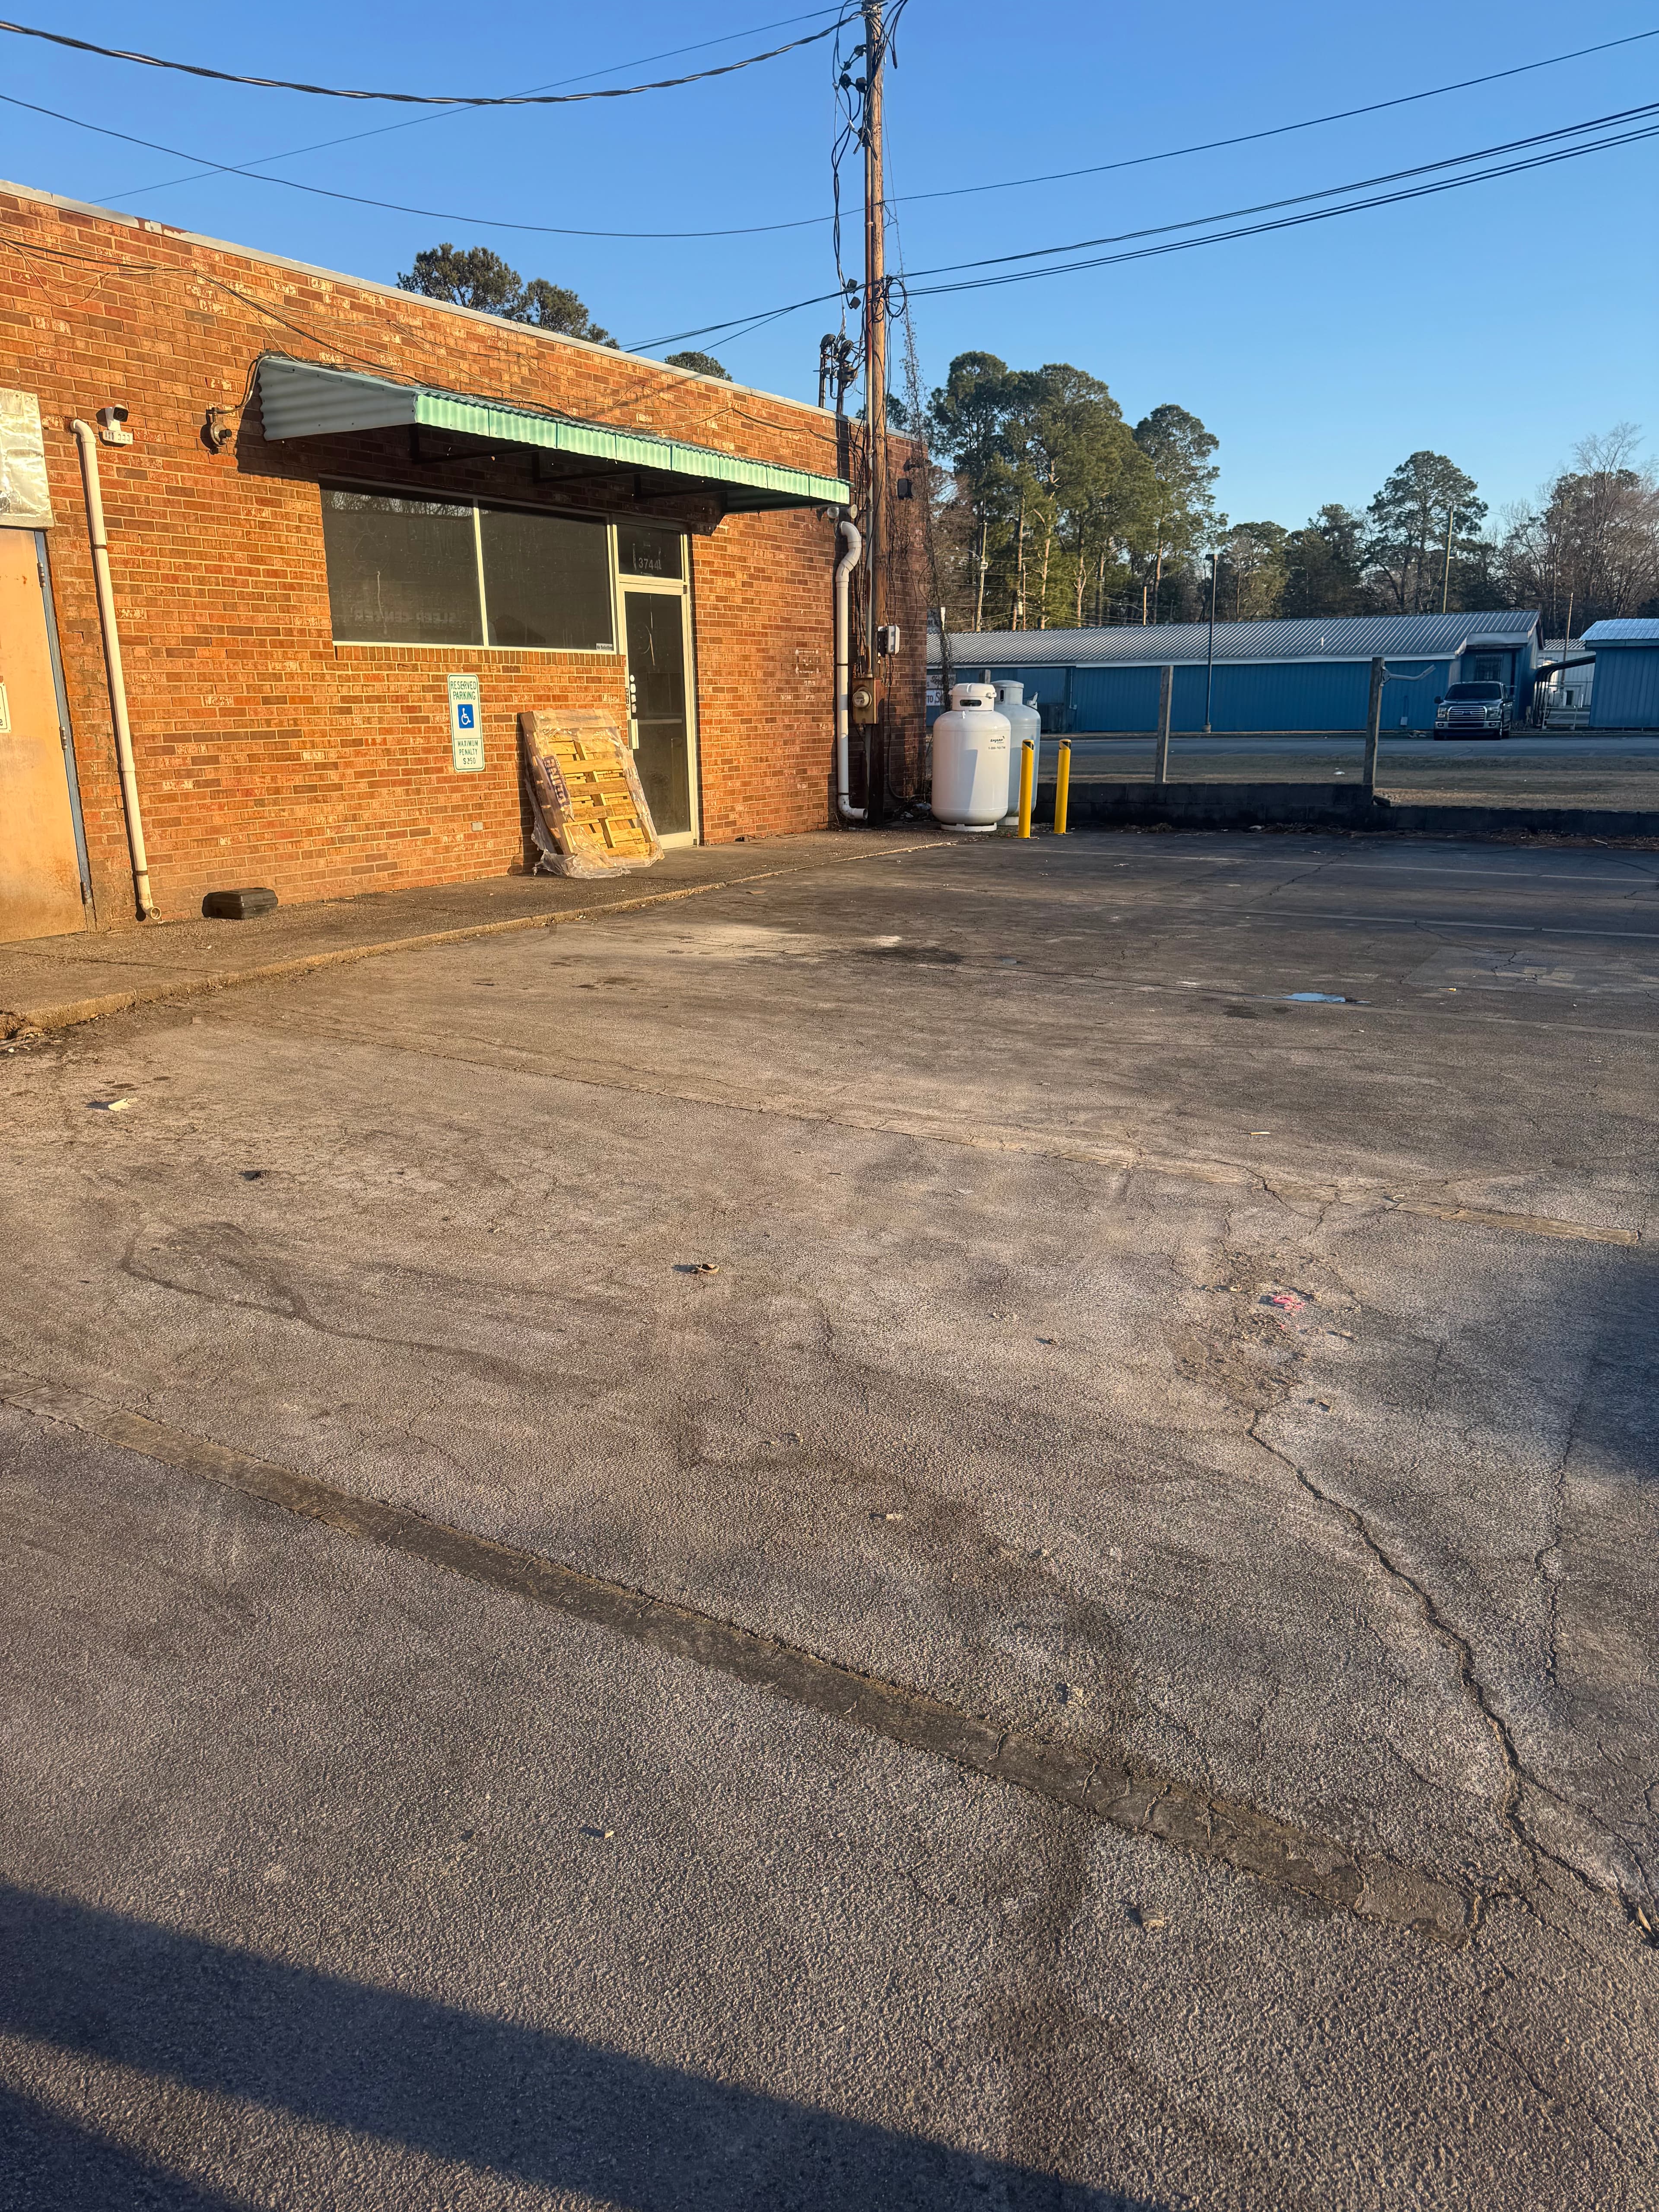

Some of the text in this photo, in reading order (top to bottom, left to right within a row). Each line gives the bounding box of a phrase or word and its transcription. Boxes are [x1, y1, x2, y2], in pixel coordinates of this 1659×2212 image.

[639, 557, 659, 570] 3744
[450, 681, 477, 690] RESERVED
[453, 691, 476, 700] PARKING
